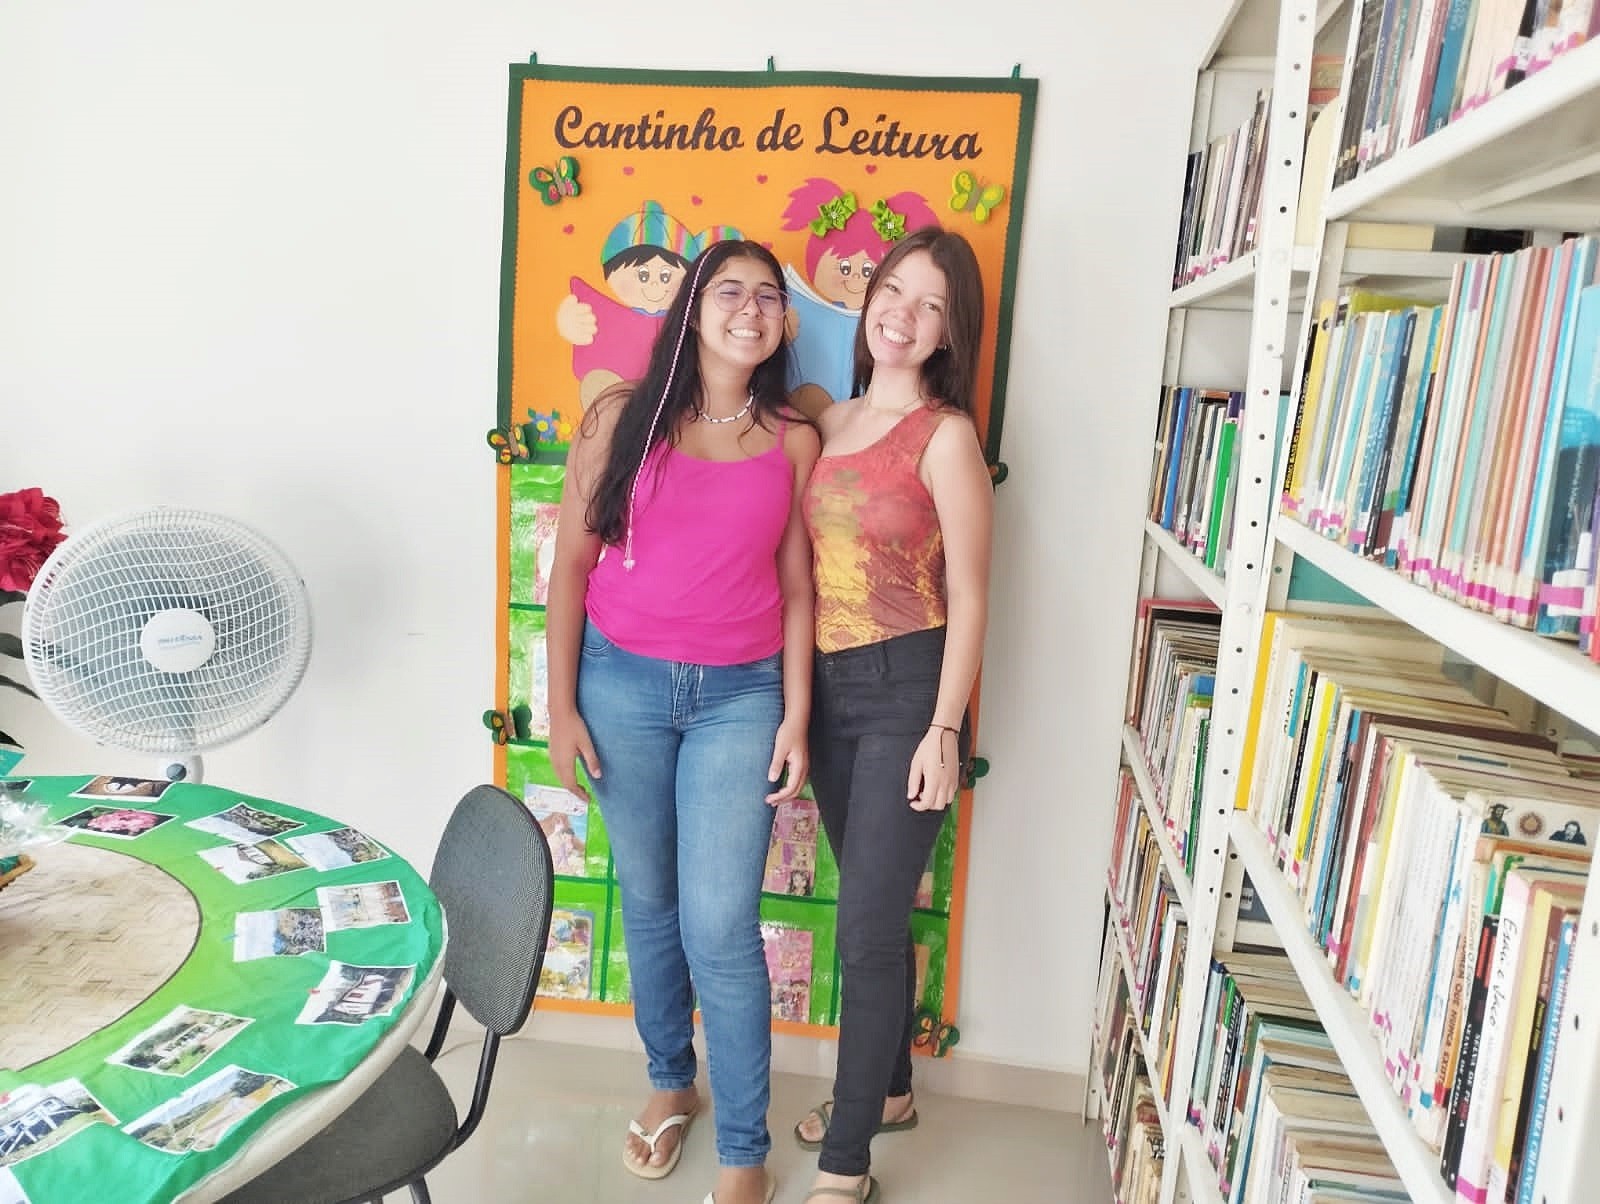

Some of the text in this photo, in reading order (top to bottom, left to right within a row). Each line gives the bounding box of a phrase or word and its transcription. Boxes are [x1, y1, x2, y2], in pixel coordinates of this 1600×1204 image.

[555, 106, 981, 160] Cantinho de Leitura
[1446, 1010, 1459, 1047] NUNCA
[1451, 1023, 1472, 1114] SELVA DE PEDRA
[1460, 1034, 1482, 1128] SELVA DE PEA
